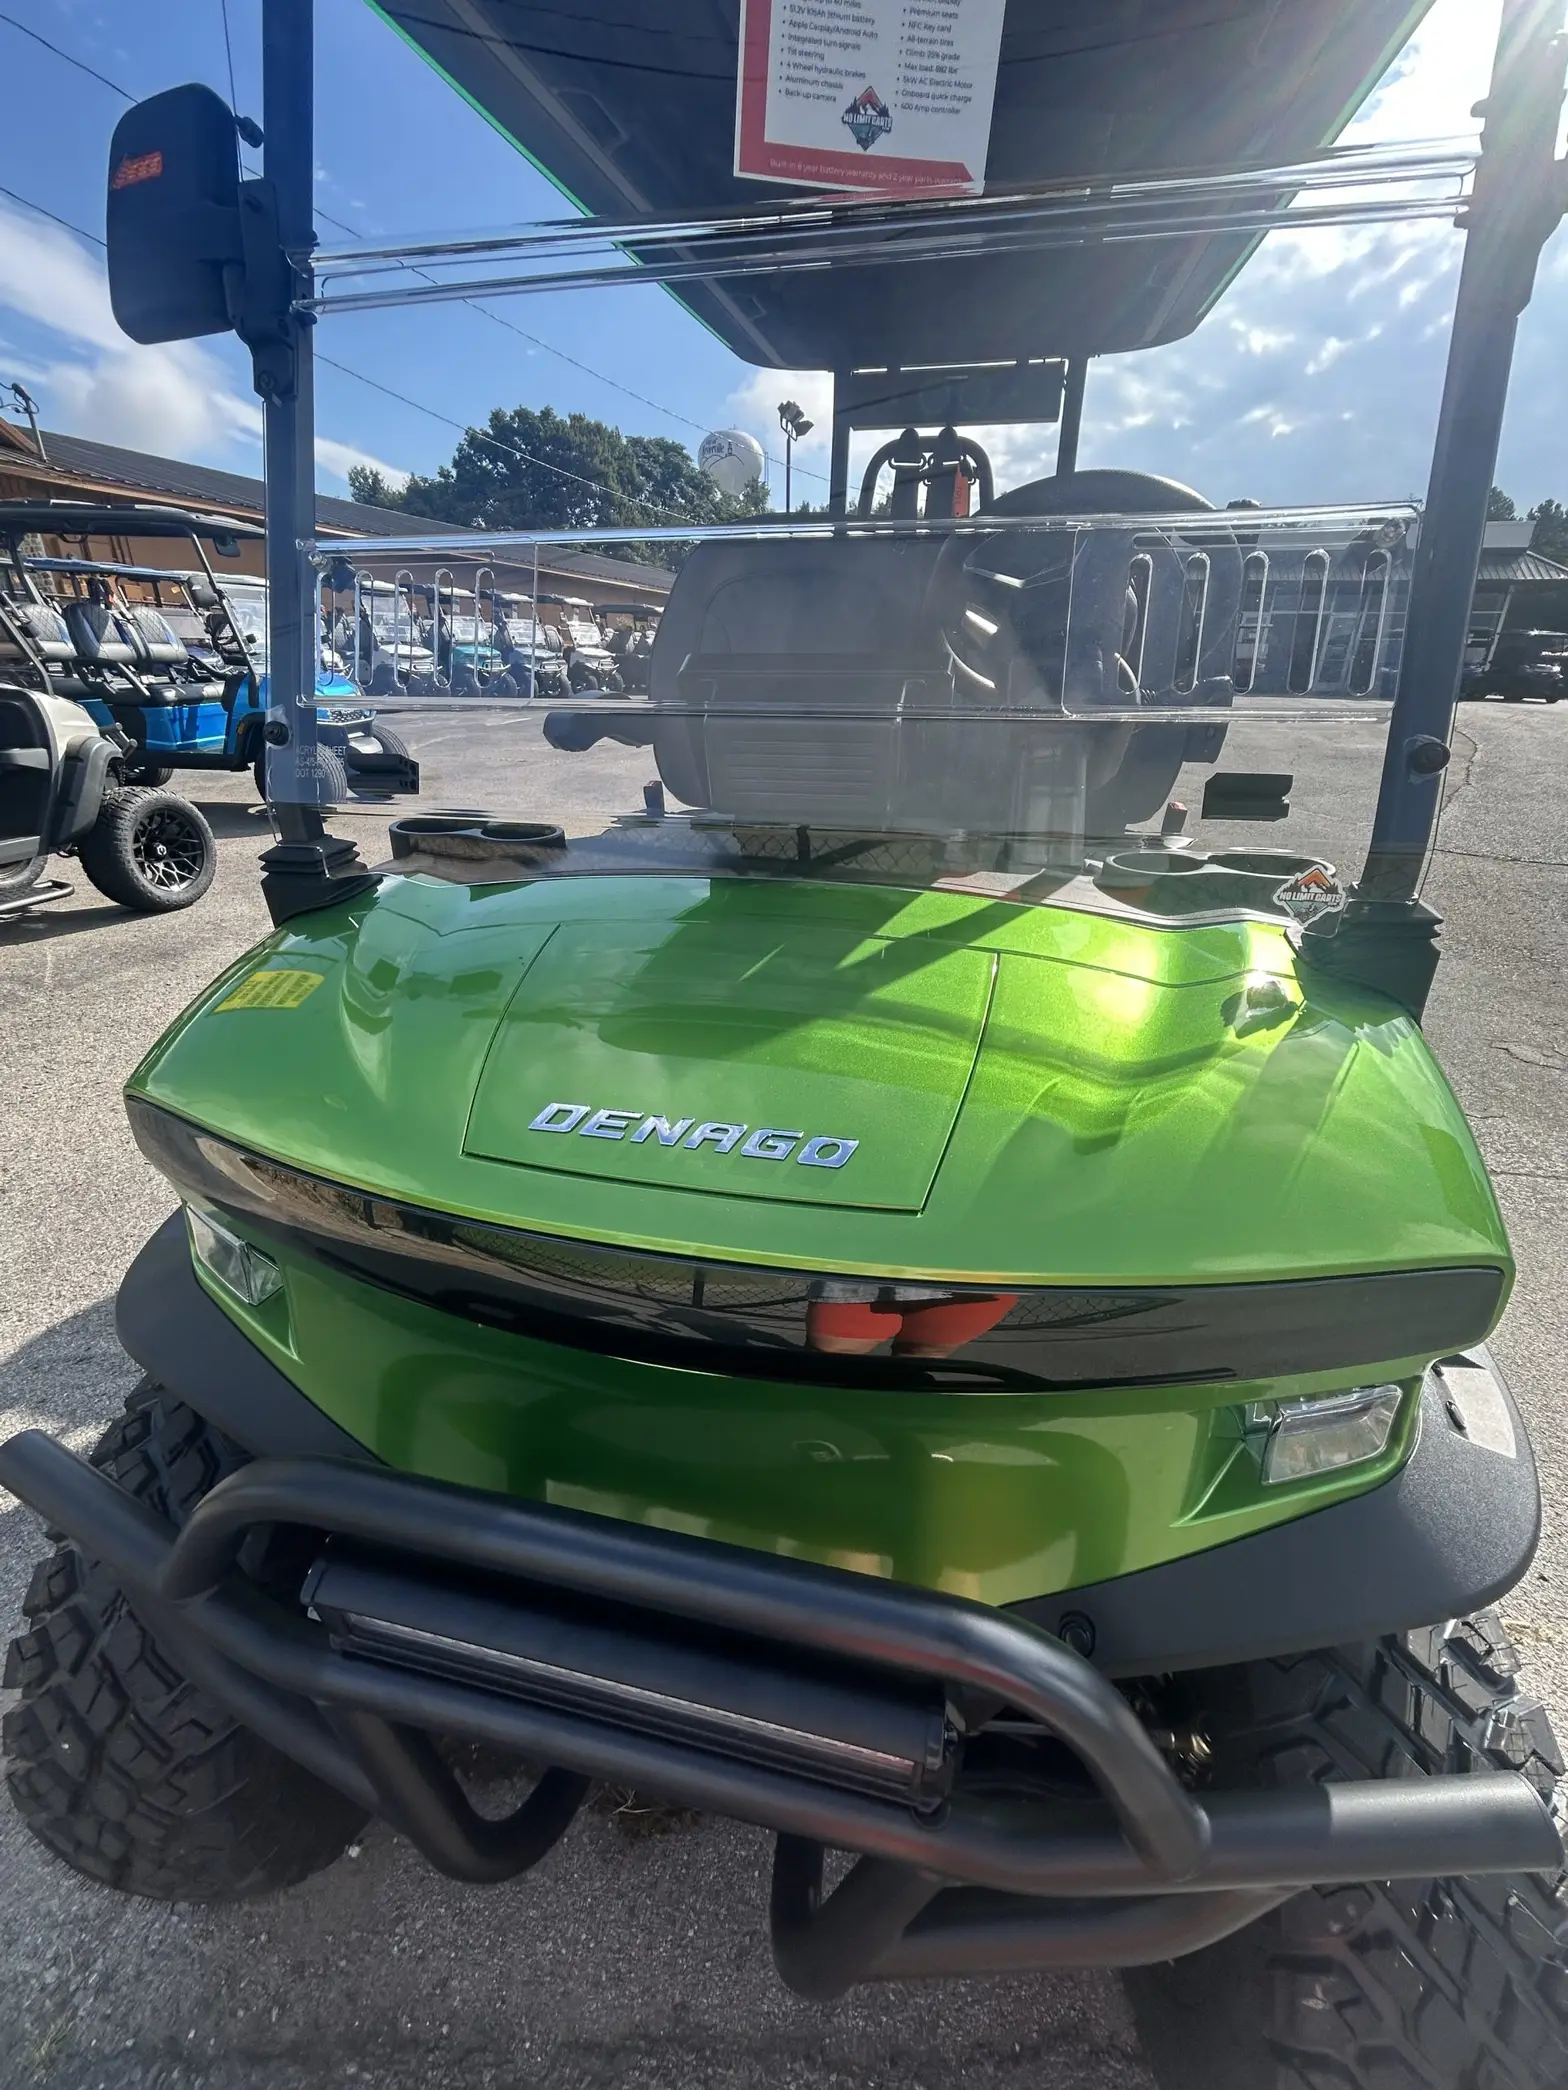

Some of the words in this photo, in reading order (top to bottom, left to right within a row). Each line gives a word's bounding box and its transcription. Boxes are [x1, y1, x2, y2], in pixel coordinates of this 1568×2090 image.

[909, 7, 940, 19] Premium
[852, 14, 875, 25] battery
[788, 19, 809, 29] Apple
[862, 29, 878, 39] Auto
[936, 24, 952, 33] card
[788, 32, 822, 45] Integrated
[824, 38, 838, 47] turn
[839, 40, 861, 51] signals
[940, 39, 954, 47] tires
[798, 48, 825, 60] steering
[940, 52, 961, 62] grade
[792, 61, 814, 71] Wheel
[814, 64, 845, 76] hydraulic
[845, 69, 867, 79] brakes
[785, 75, 820, 87] Aluminum
[820, 79, 844, 90] chassis
[929, 77, 953, 88] Electric
[953, 81, 973, 90] Motor
[812, 93, 837, 103] camera
[901, 88, 930, 99] Onboard
[931, 91, 948, 102] quick
[949, 94, 972, 104] charge
[914, 103, 929, 113] Amp
[930, 104, 961, 115] controller
[853, 114, 871, 125] LIMIT
[803, 163, 818, 174] year
[819, 164, 845, 177] battery
[845, 168, 877, 181] warranty
[878, 171, 892, 181] and
[1279, 891, 1291, 900] NO
[1292, 892, 1315, 901] LIMIT
[1315, 893, 1341, 903] CARTS
[528, 1101, 860, 1169] DENAGO
